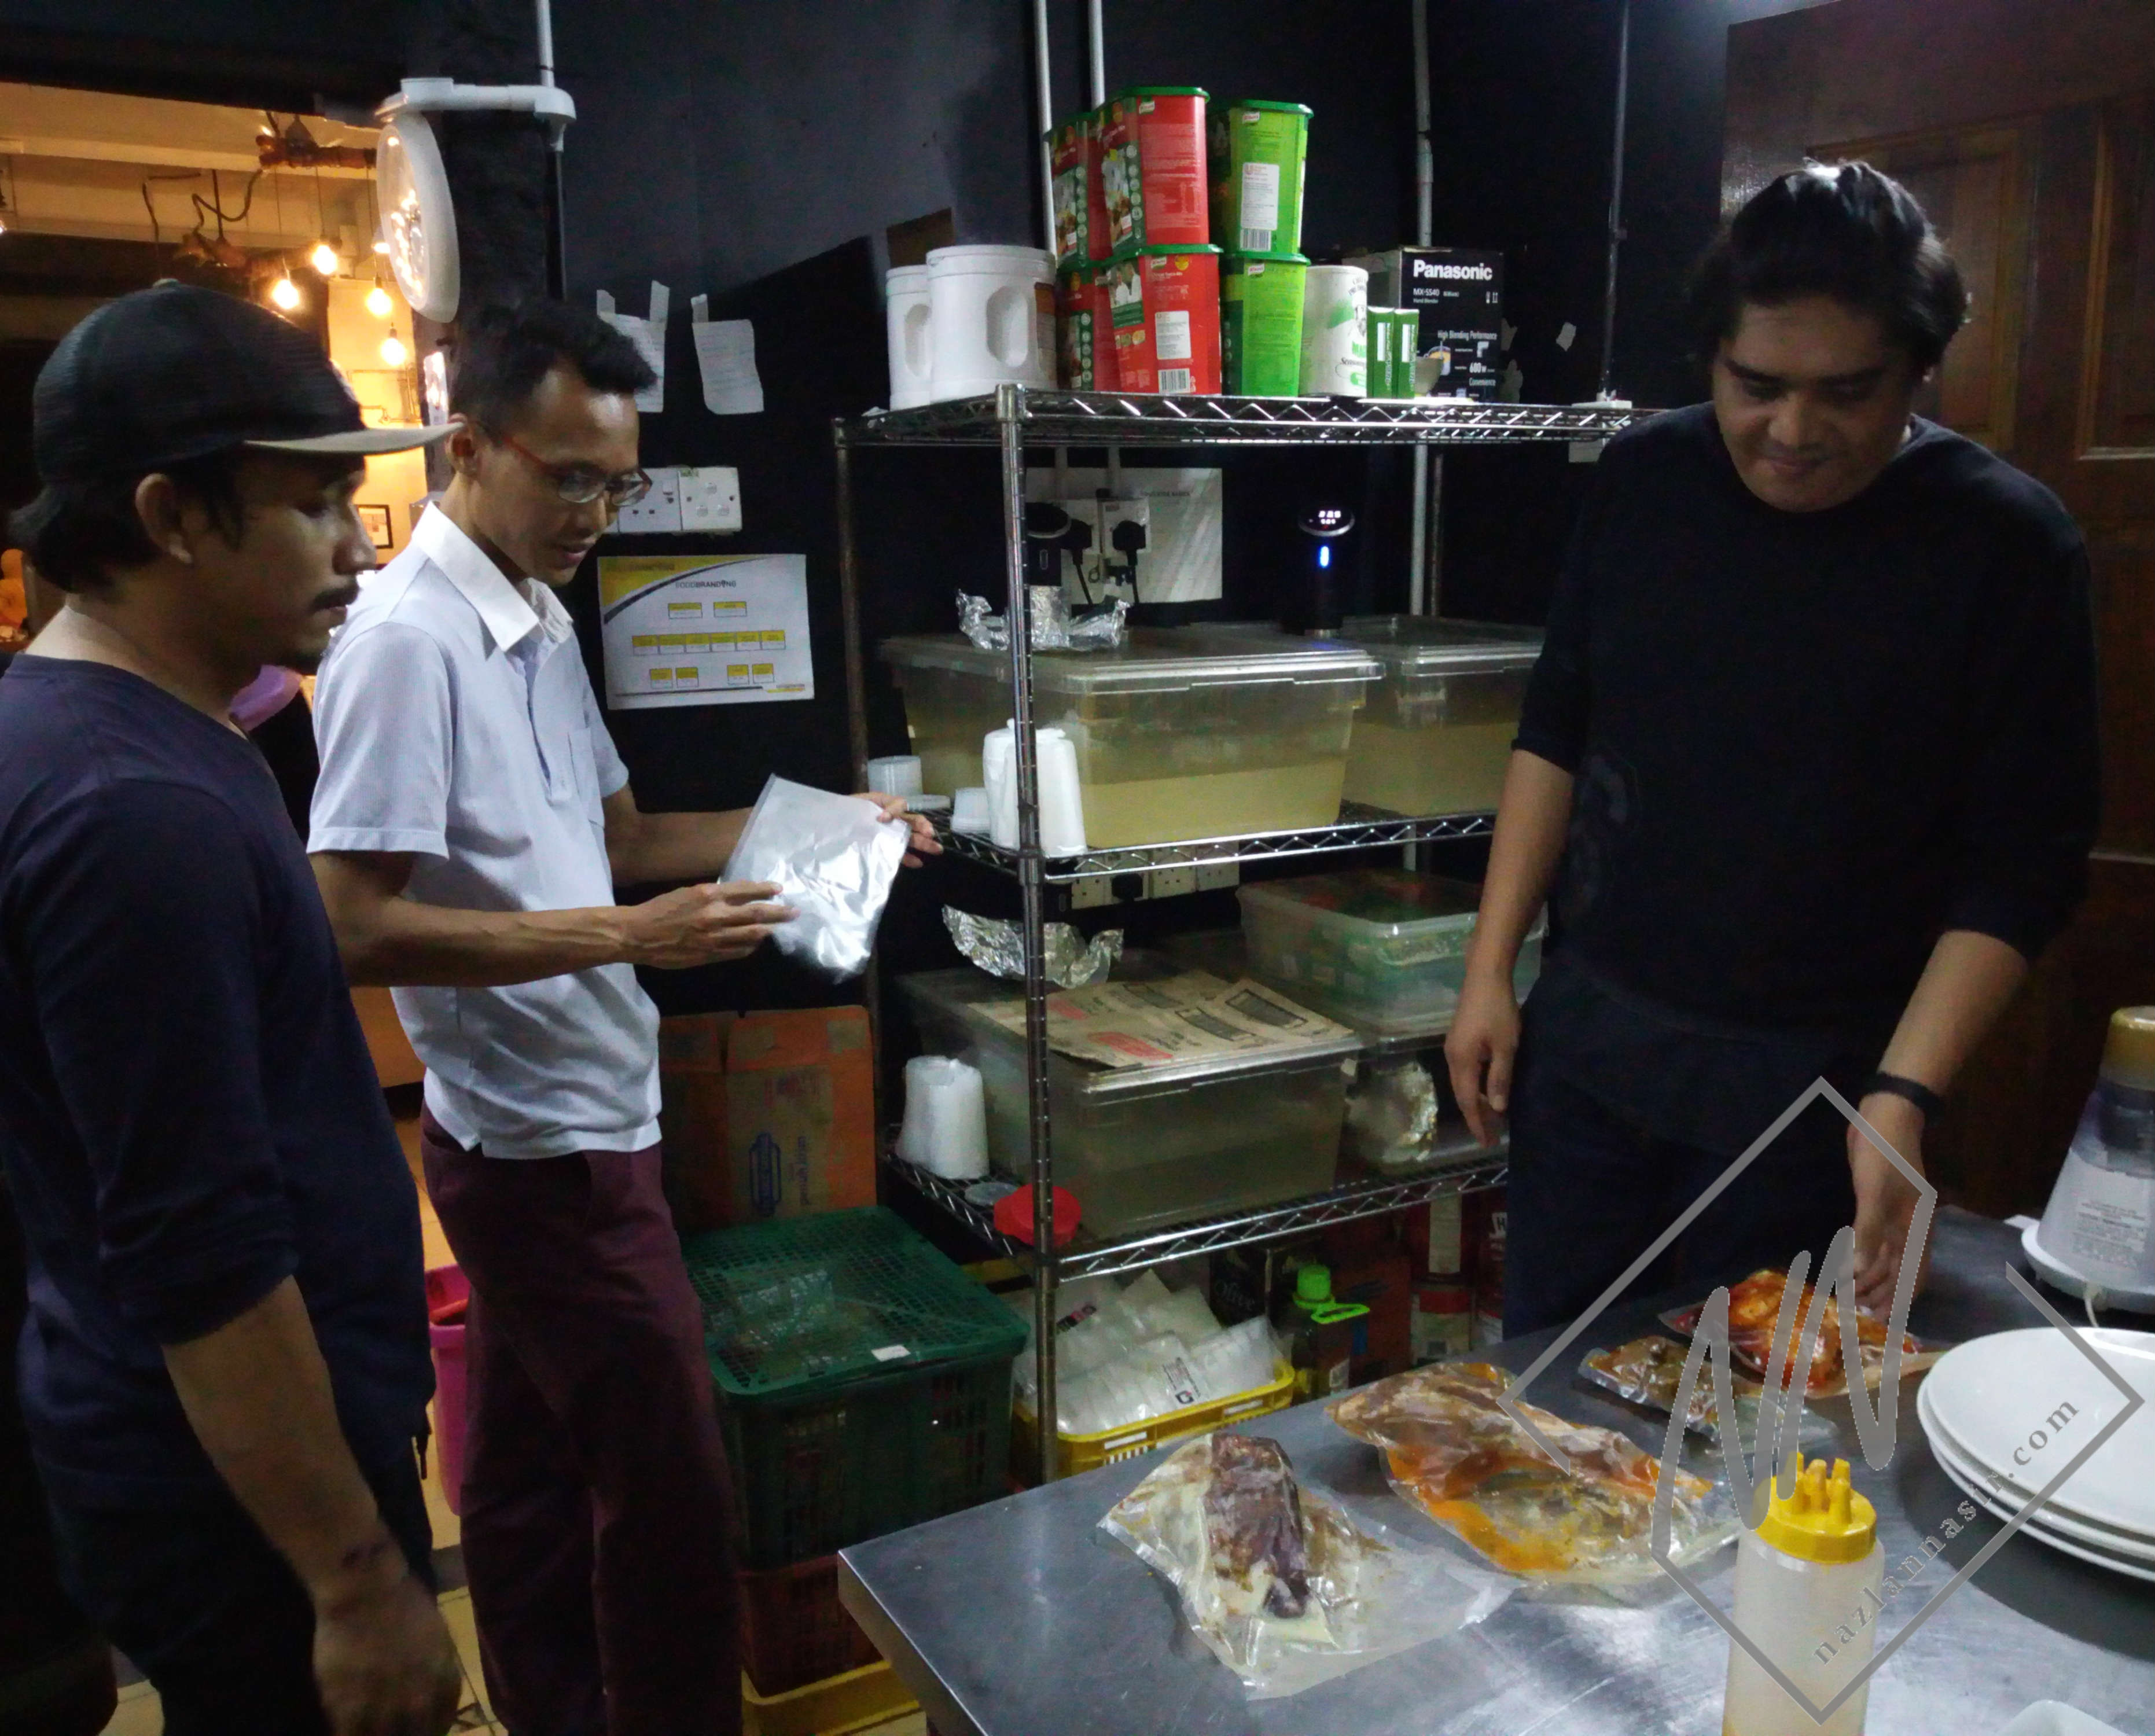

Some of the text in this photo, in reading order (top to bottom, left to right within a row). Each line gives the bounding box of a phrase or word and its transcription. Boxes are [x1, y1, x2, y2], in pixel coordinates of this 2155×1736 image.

[1413, 259, 1492, 281] Panasonic
[1449, 330, 1469, 341] Blending
[1470, 330, 1497, 340] Performance
[1469, 378, 1496, 387] Convenience
